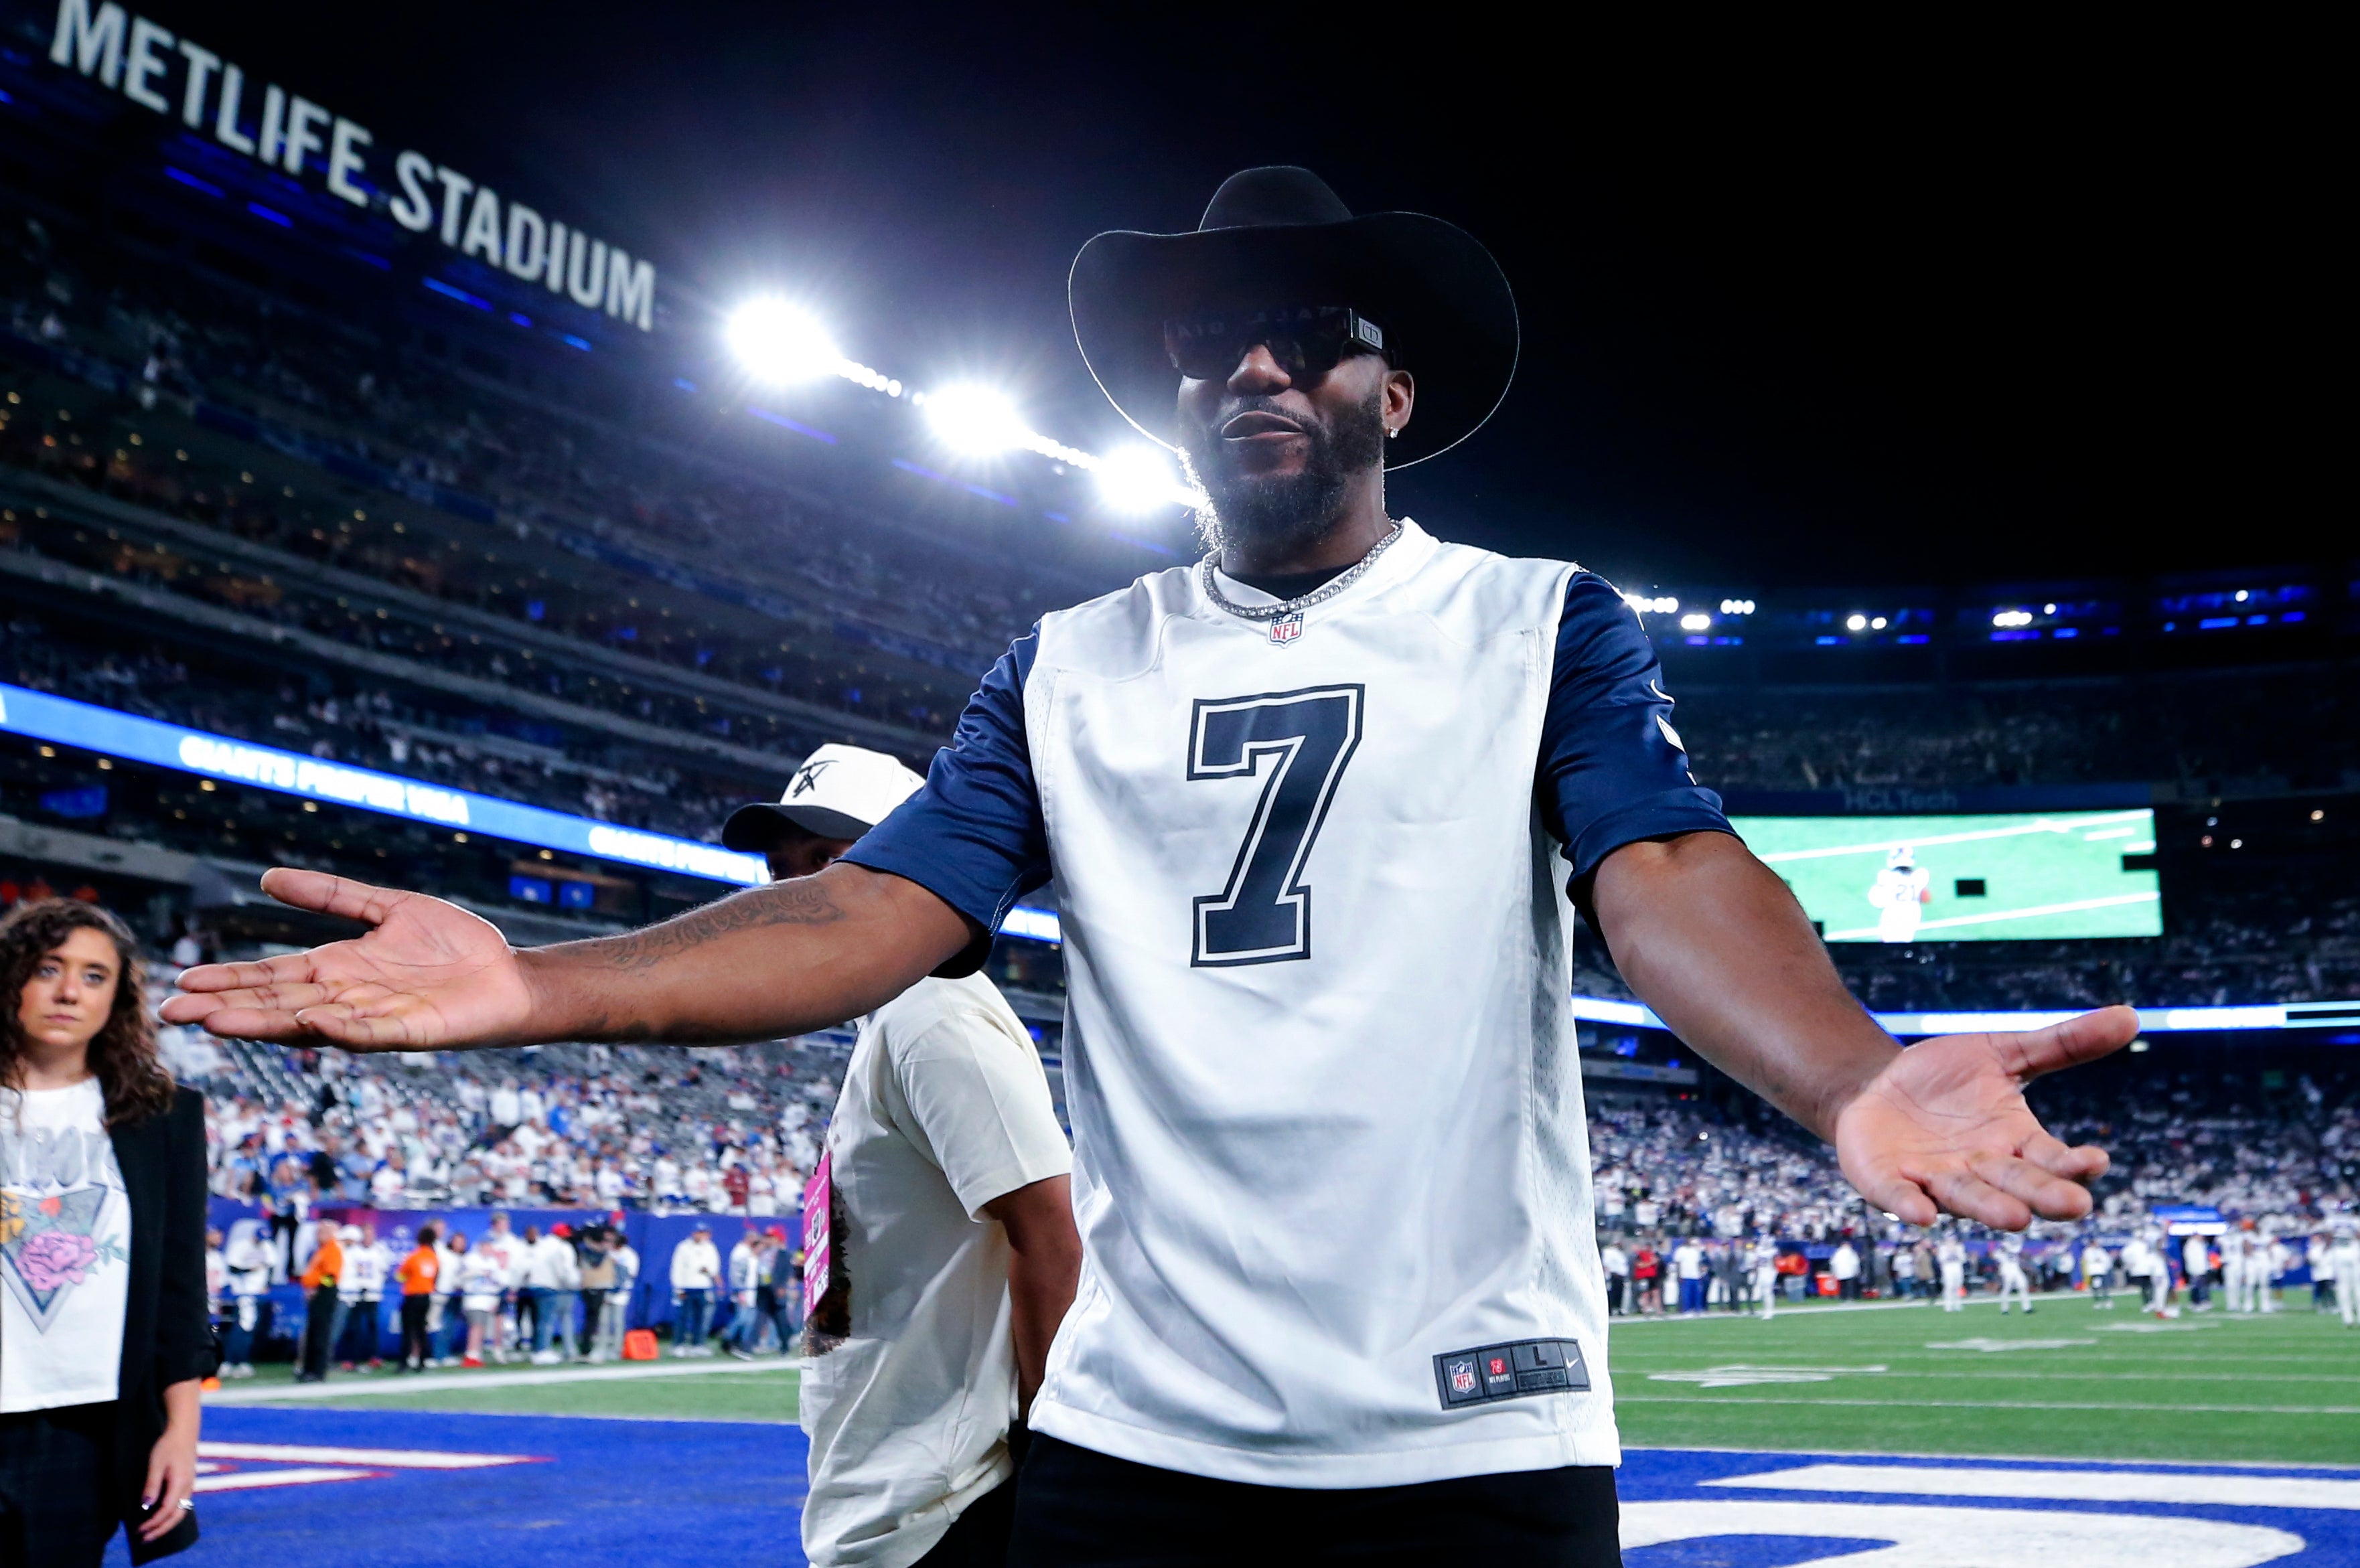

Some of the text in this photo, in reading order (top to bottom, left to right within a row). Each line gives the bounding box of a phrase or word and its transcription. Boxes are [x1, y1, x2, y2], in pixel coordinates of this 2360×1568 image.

[49, 0, 657, 333] METLIFE STADIUM
[1272, 623, 1299, 640] NFL
[1844, 789, 1959, 811] HCLTech
[1186, 684, 1365, 968] 7
[1895, 884, 1919, 902] 21
[1532, 1346, 1547, 1366] L
[1456, 1374, 1472, 1389] NFL
